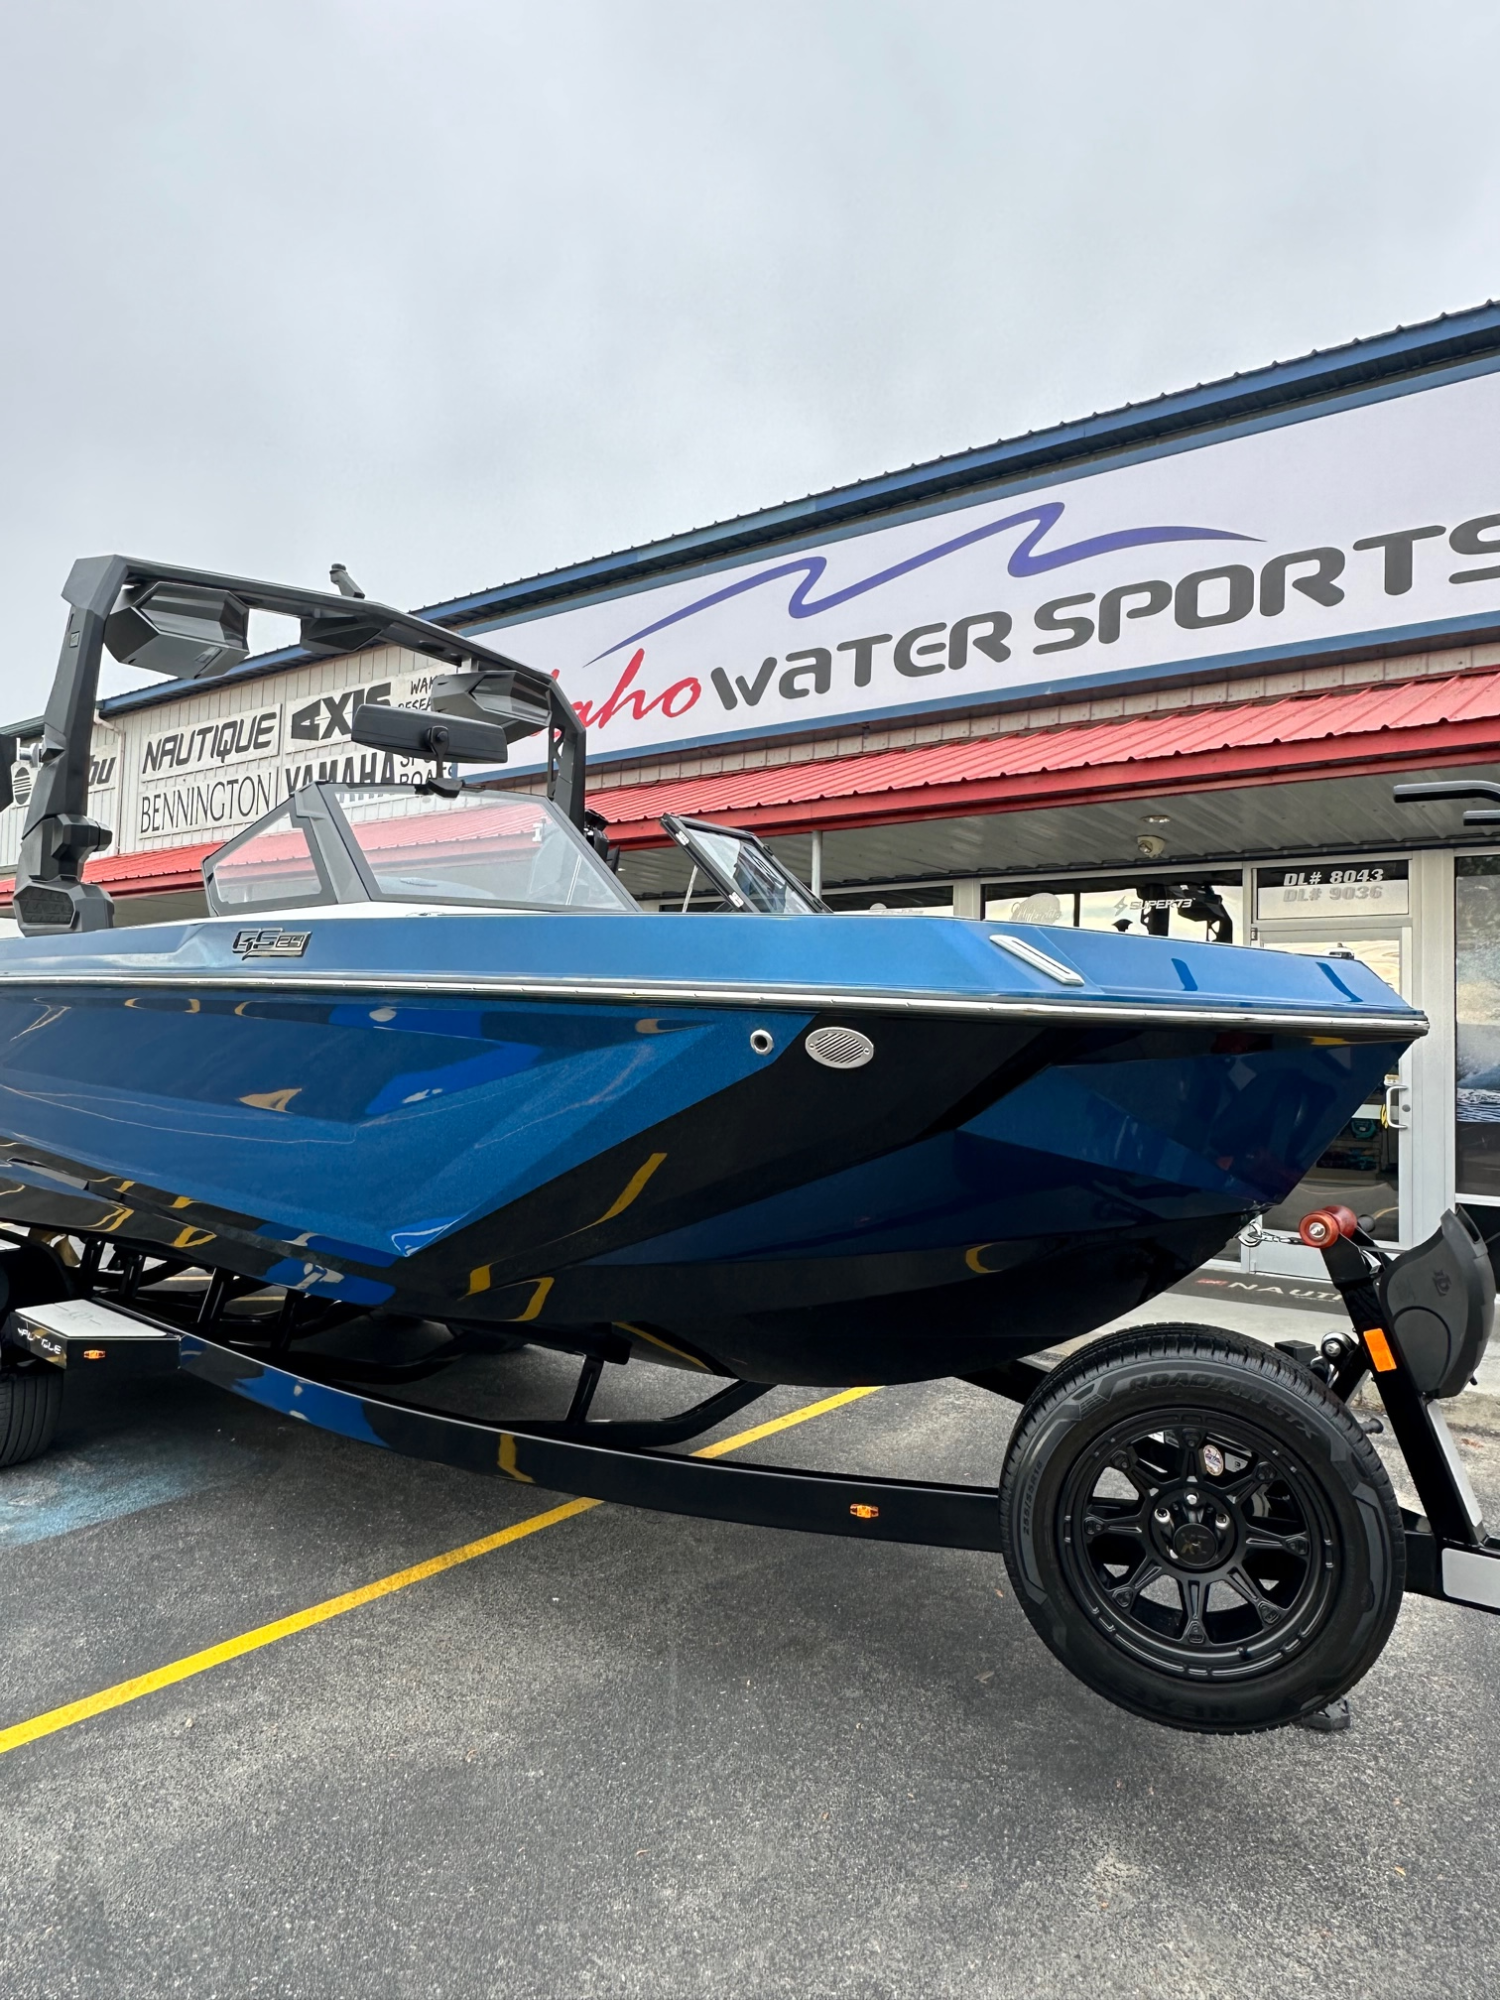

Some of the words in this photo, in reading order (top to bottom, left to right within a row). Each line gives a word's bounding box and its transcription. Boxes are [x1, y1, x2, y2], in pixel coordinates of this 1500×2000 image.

[1033, 513, 1500, 655] SPORTS
[142, 711, 277, 775] NAUTIQUE
[140, 772, 272, 834] BENNINGTON
[285, 752, 396, 802] YAMAHA
[1283, 872, 1322, 887] DL#
[1329, 868, 1384, 884] 8043
[1283, 887, 1322, 902] DL#
[1329, 885, 1383, 900] 9036
